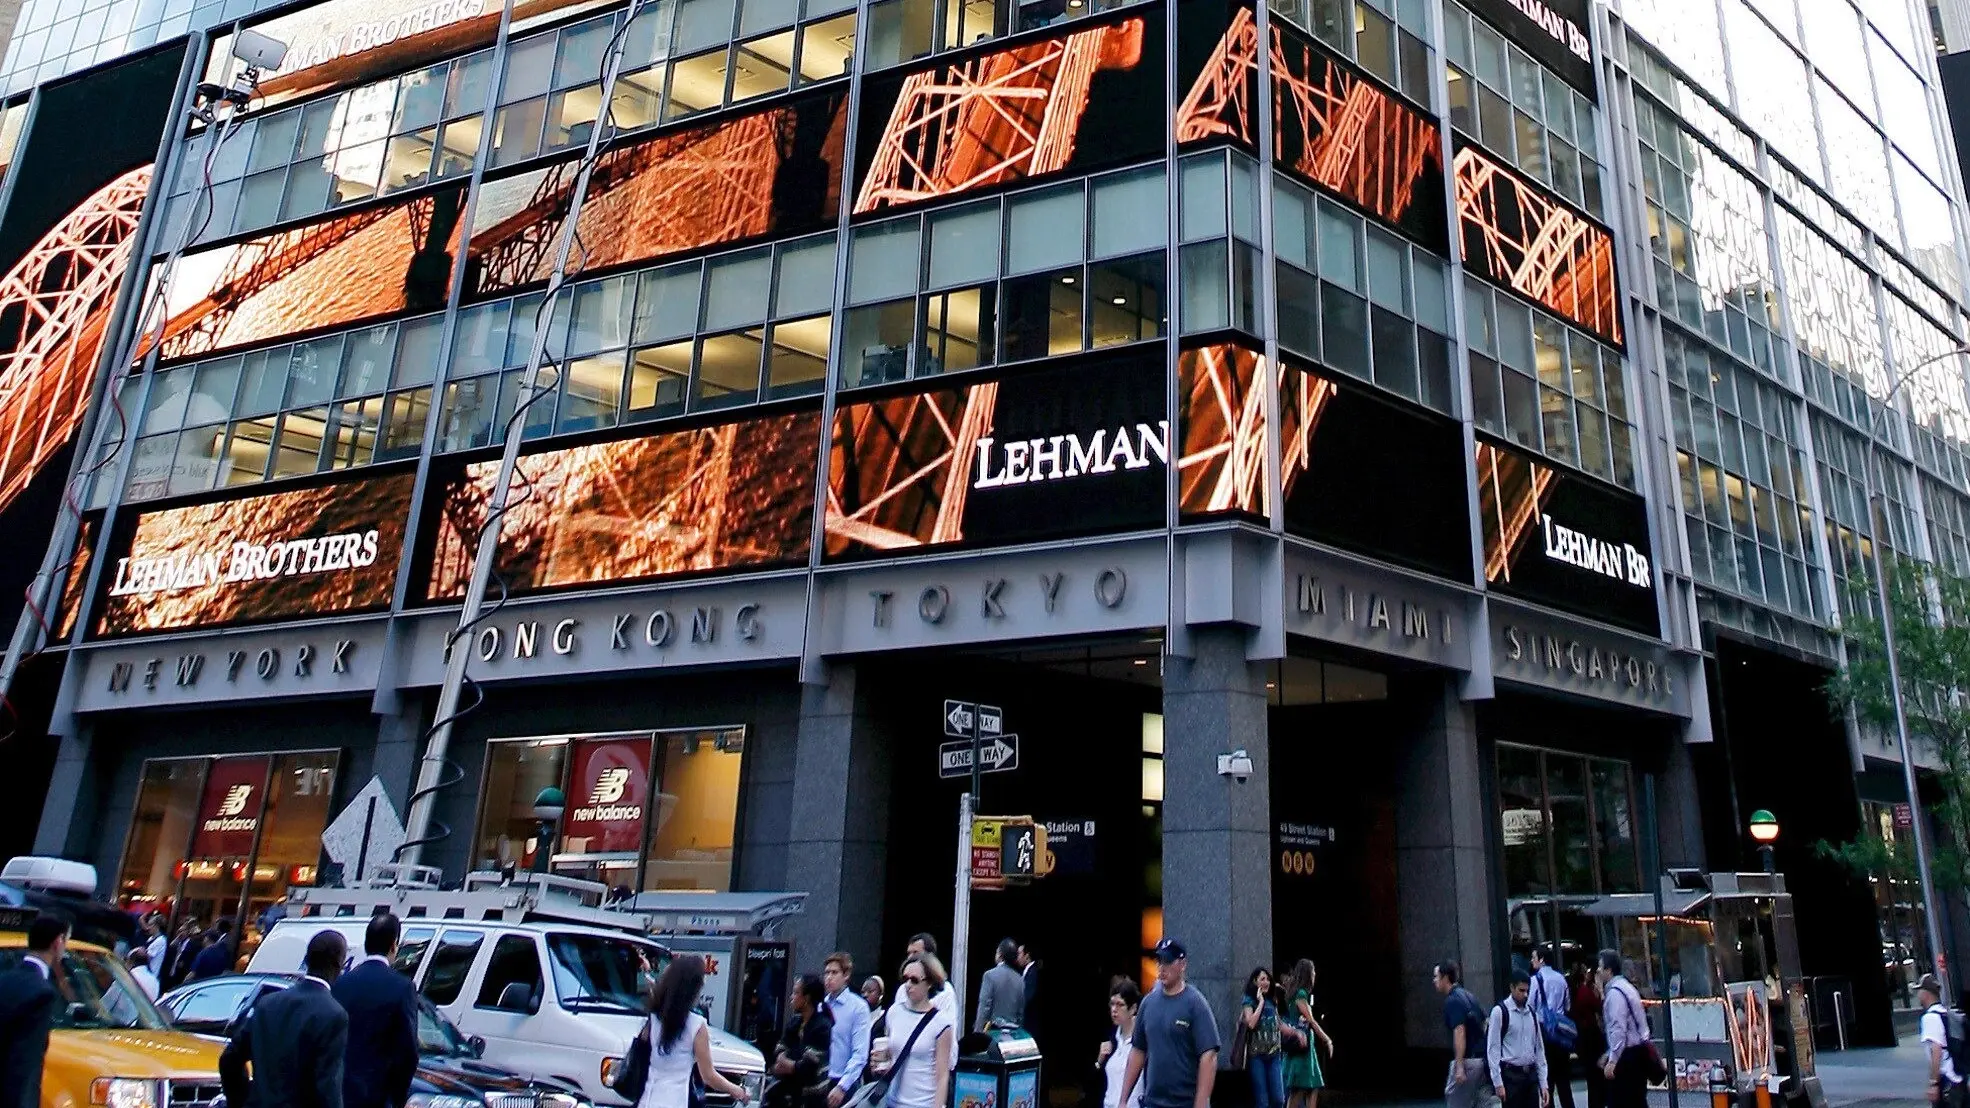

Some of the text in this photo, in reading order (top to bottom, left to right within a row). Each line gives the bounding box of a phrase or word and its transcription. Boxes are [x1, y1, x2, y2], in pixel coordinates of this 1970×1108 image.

[347, 0, 485, 55] BROTHERS
[974, 420, 1169, 489] LEHMAN
[109, 530, 378, 597] LEHMAN BROTHERS
[1542, 513, 1651, 588] LEHMAN BR
[870, 566, 1126, 628] TOKYO
[1300, 574, 1452, 644] MIAMI
[611, 603, 762, 651] KONG
[108, 640, 355, 692] NEW YORK
[1506, 625, 1673, 695] SINGAPORE
[953, 711, 993, 728] ONE AY
[950, 746, 1005, 766] ONE WAY
[595, 804, 641, 821] balance
[1046, 821, 1080, 833] Station
